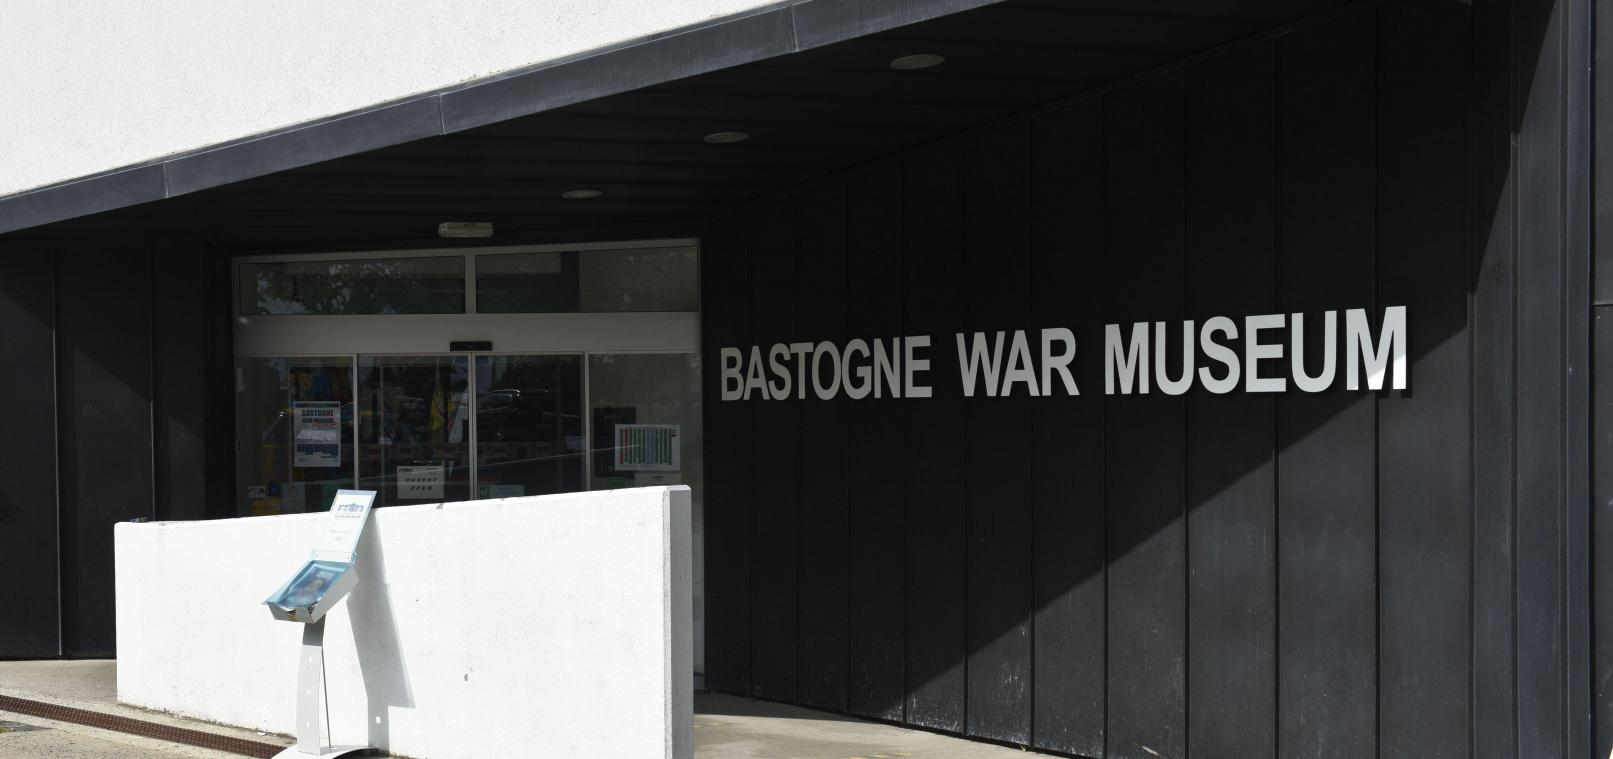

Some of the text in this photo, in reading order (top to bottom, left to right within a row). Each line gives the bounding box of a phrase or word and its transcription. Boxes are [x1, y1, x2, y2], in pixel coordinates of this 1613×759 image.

[720, 305, 1407, 401] BASTOGNE WAR MUSEUM
